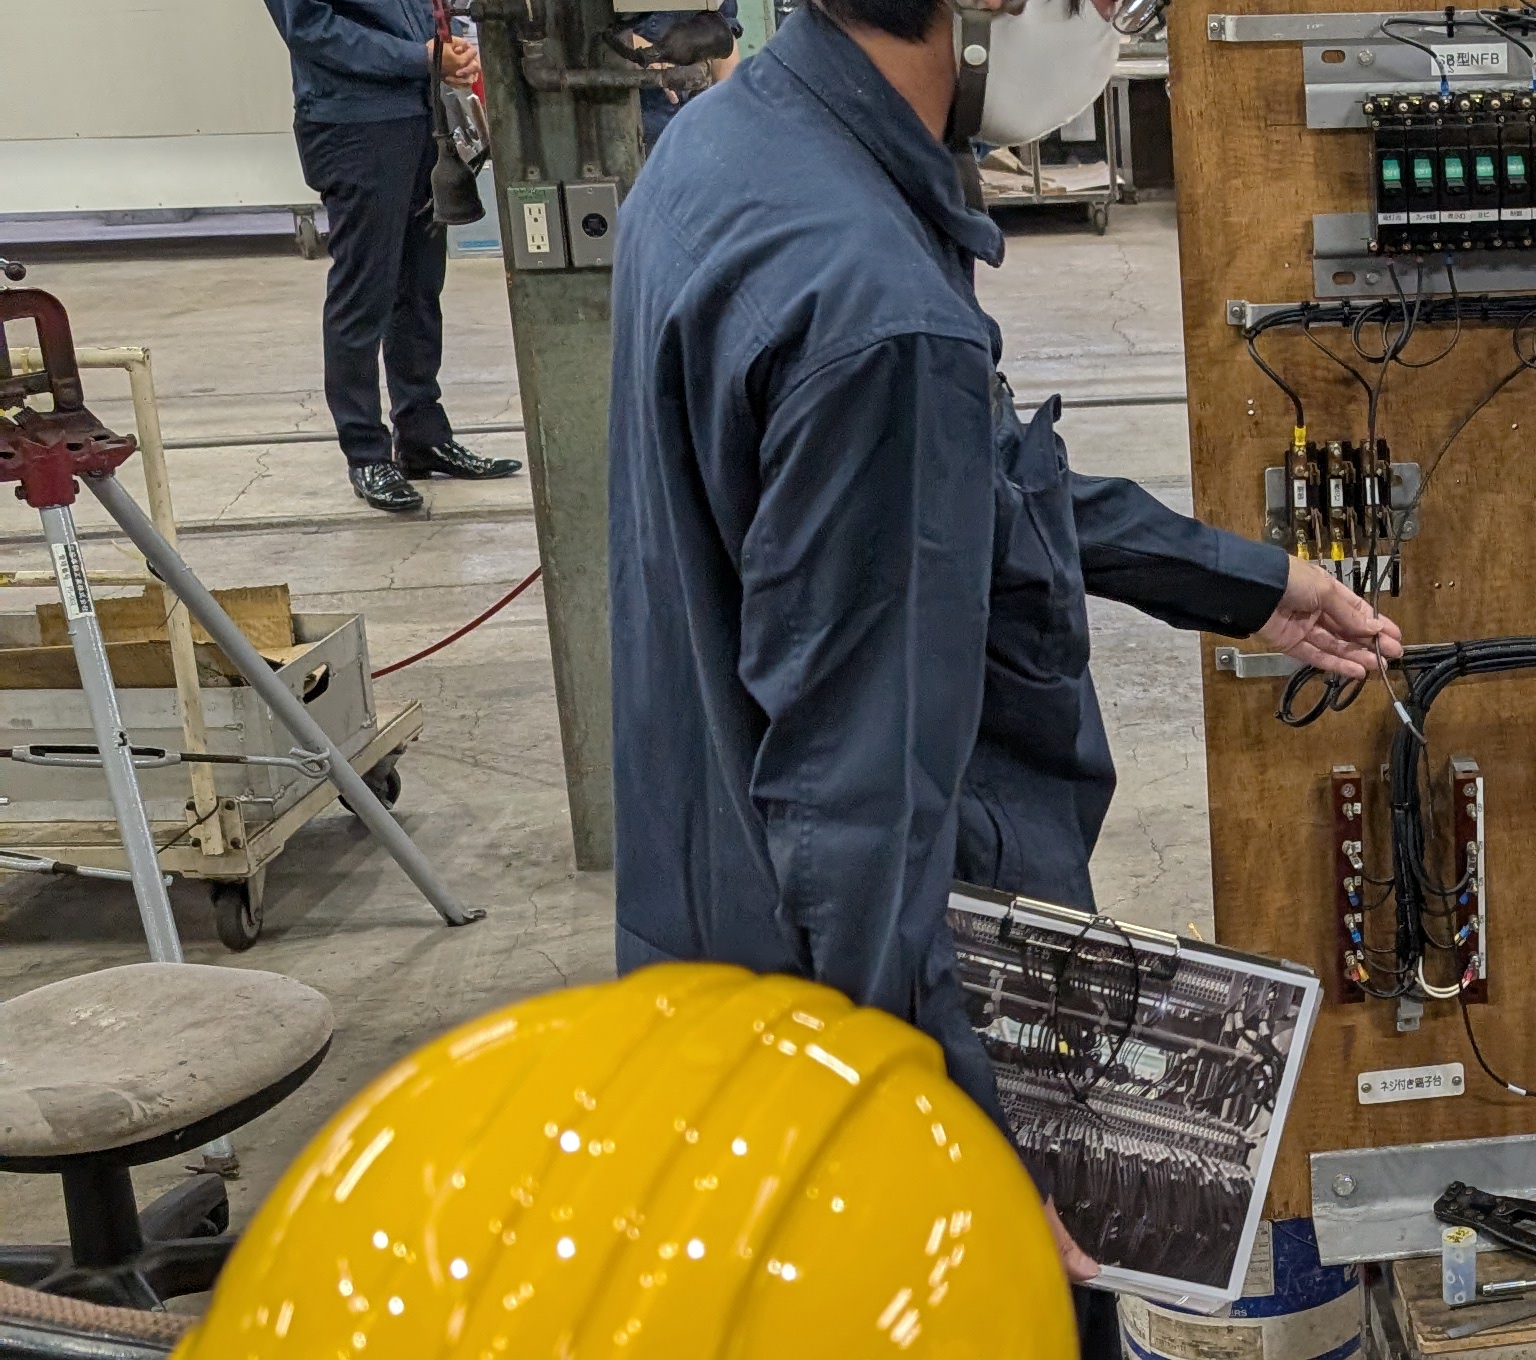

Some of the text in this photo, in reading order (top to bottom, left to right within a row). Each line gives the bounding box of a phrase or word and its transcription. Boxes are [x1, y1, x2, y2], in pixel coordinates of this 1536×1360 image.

[1380, 1074, 1442, 1092] ネジ付き端子台
